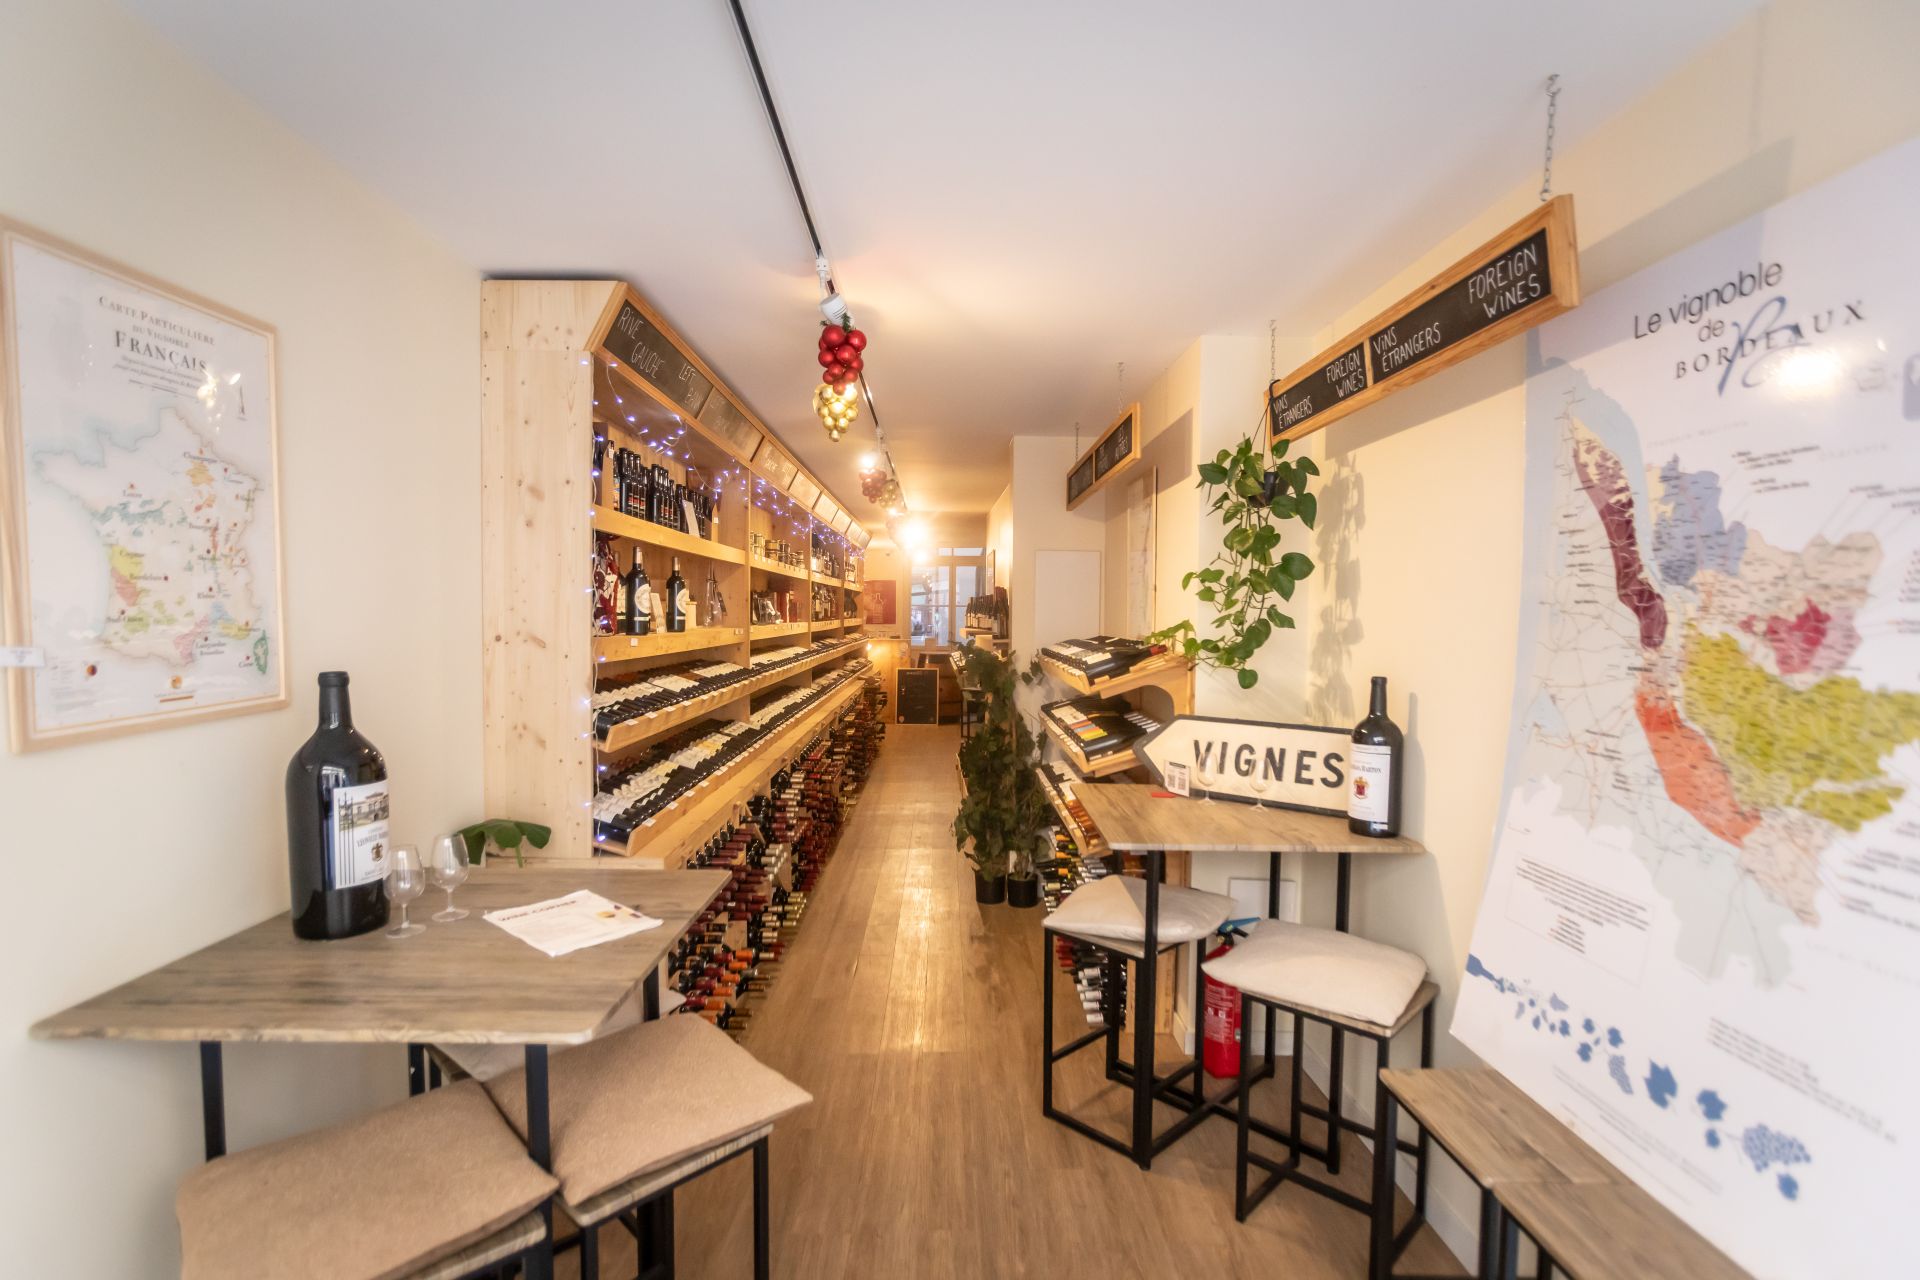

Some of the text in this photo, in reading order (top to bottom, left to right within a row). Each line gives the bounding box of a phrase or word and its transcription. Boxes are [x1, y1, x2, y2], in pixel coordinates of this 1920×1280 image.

[1467, 242, 1537, 304] FOREIGN
[98, 295, 137, 319] CARTE
[1482, 273, 1541, 319] WINES
[1633, 261, 1783, 340] Le vignoble
[617, 306, 645, 340] RIVE
[1372, 325, 1398, 355] VINS
[1697, 318, 1725, 343] de
[114, 329, 209, 371] FRANÇAIS
[630, 341, 666, 380] GAUCHE
[1325, 349, 1361, 384] FOREIGN
[678, 362, 697, 385] LEFT
[1335, 368, 1365, 399] WINES
[1193, 738, 1345, 789] VIGNES
